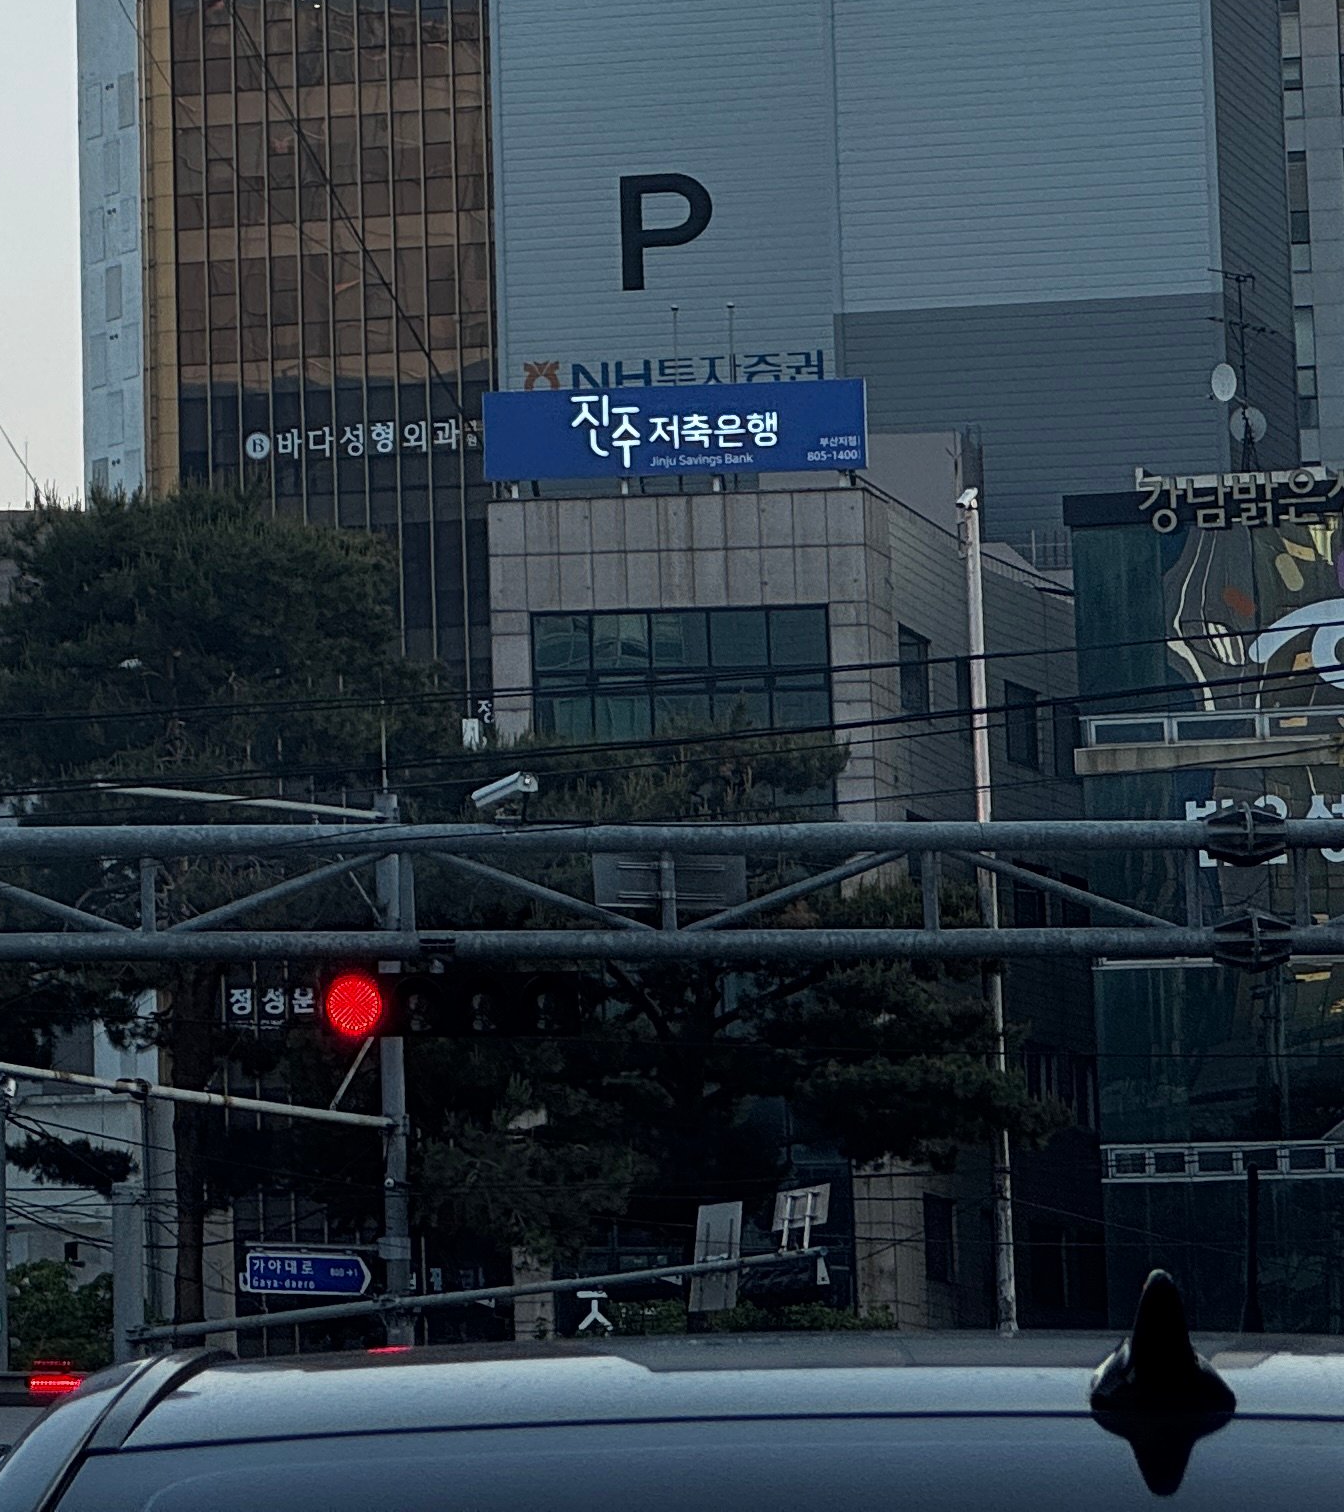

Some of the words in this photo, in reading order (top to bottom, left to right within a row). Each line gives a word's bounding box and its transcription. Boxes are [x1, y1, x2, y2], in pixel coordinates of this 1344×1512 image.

[620, 173, 713, 291] P
[276, 418, 461, 460] 바다성형외과
[570, 394, 641, 469] 진주
[649, 411, 778, 450] 저축은행
[649, 455, 677, 468] Jinju
[679, 454, 722, 468] Savings
[725, 452, 754, 464] Bank
[807, 449, 858, 462] 805-1400
[252, 1258, 315, 1276] 가야대로
